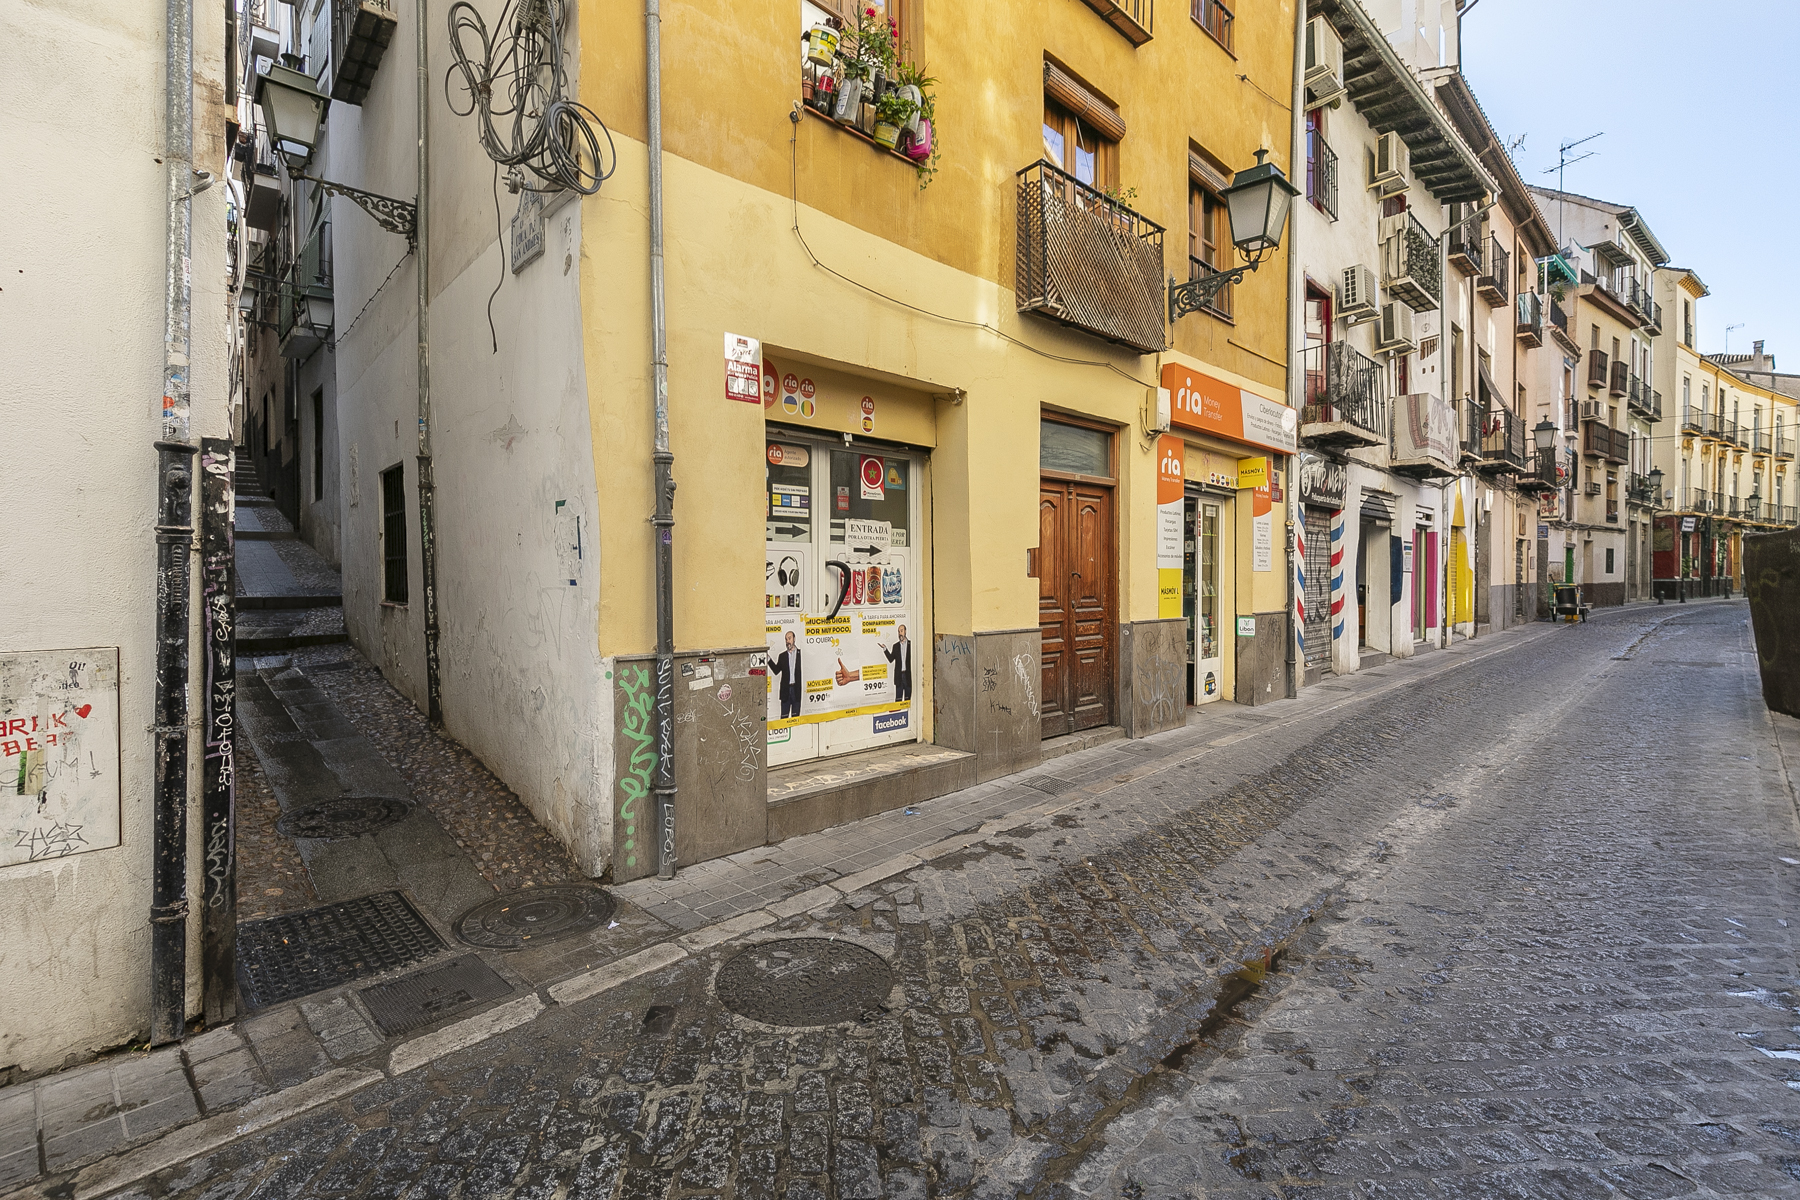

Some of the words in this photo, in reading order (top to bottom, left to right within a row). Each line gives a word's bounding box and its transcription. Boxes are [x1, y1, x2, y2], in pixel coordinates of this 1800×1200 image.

[727, 361, 758, 375] Alarma
[784, 376, 797, 388] ria
[801, 380, 814, 392] ria
[1177, 377, 1202, 415] ria
[862, 398, 873, 409] ria
[1203, 395, 1221, 410] Money
[1203, 407, 1223, 421] Transfer
[769, 446, 782, 457] ria
[1161, 449, 1181, 476] ria
[850, 524, 888, 534] ENTRADA
[806, 627, 820, 635] POR
[815, 636, 833, 644] QUIERO
[875, 716, 907, 730] facebook
